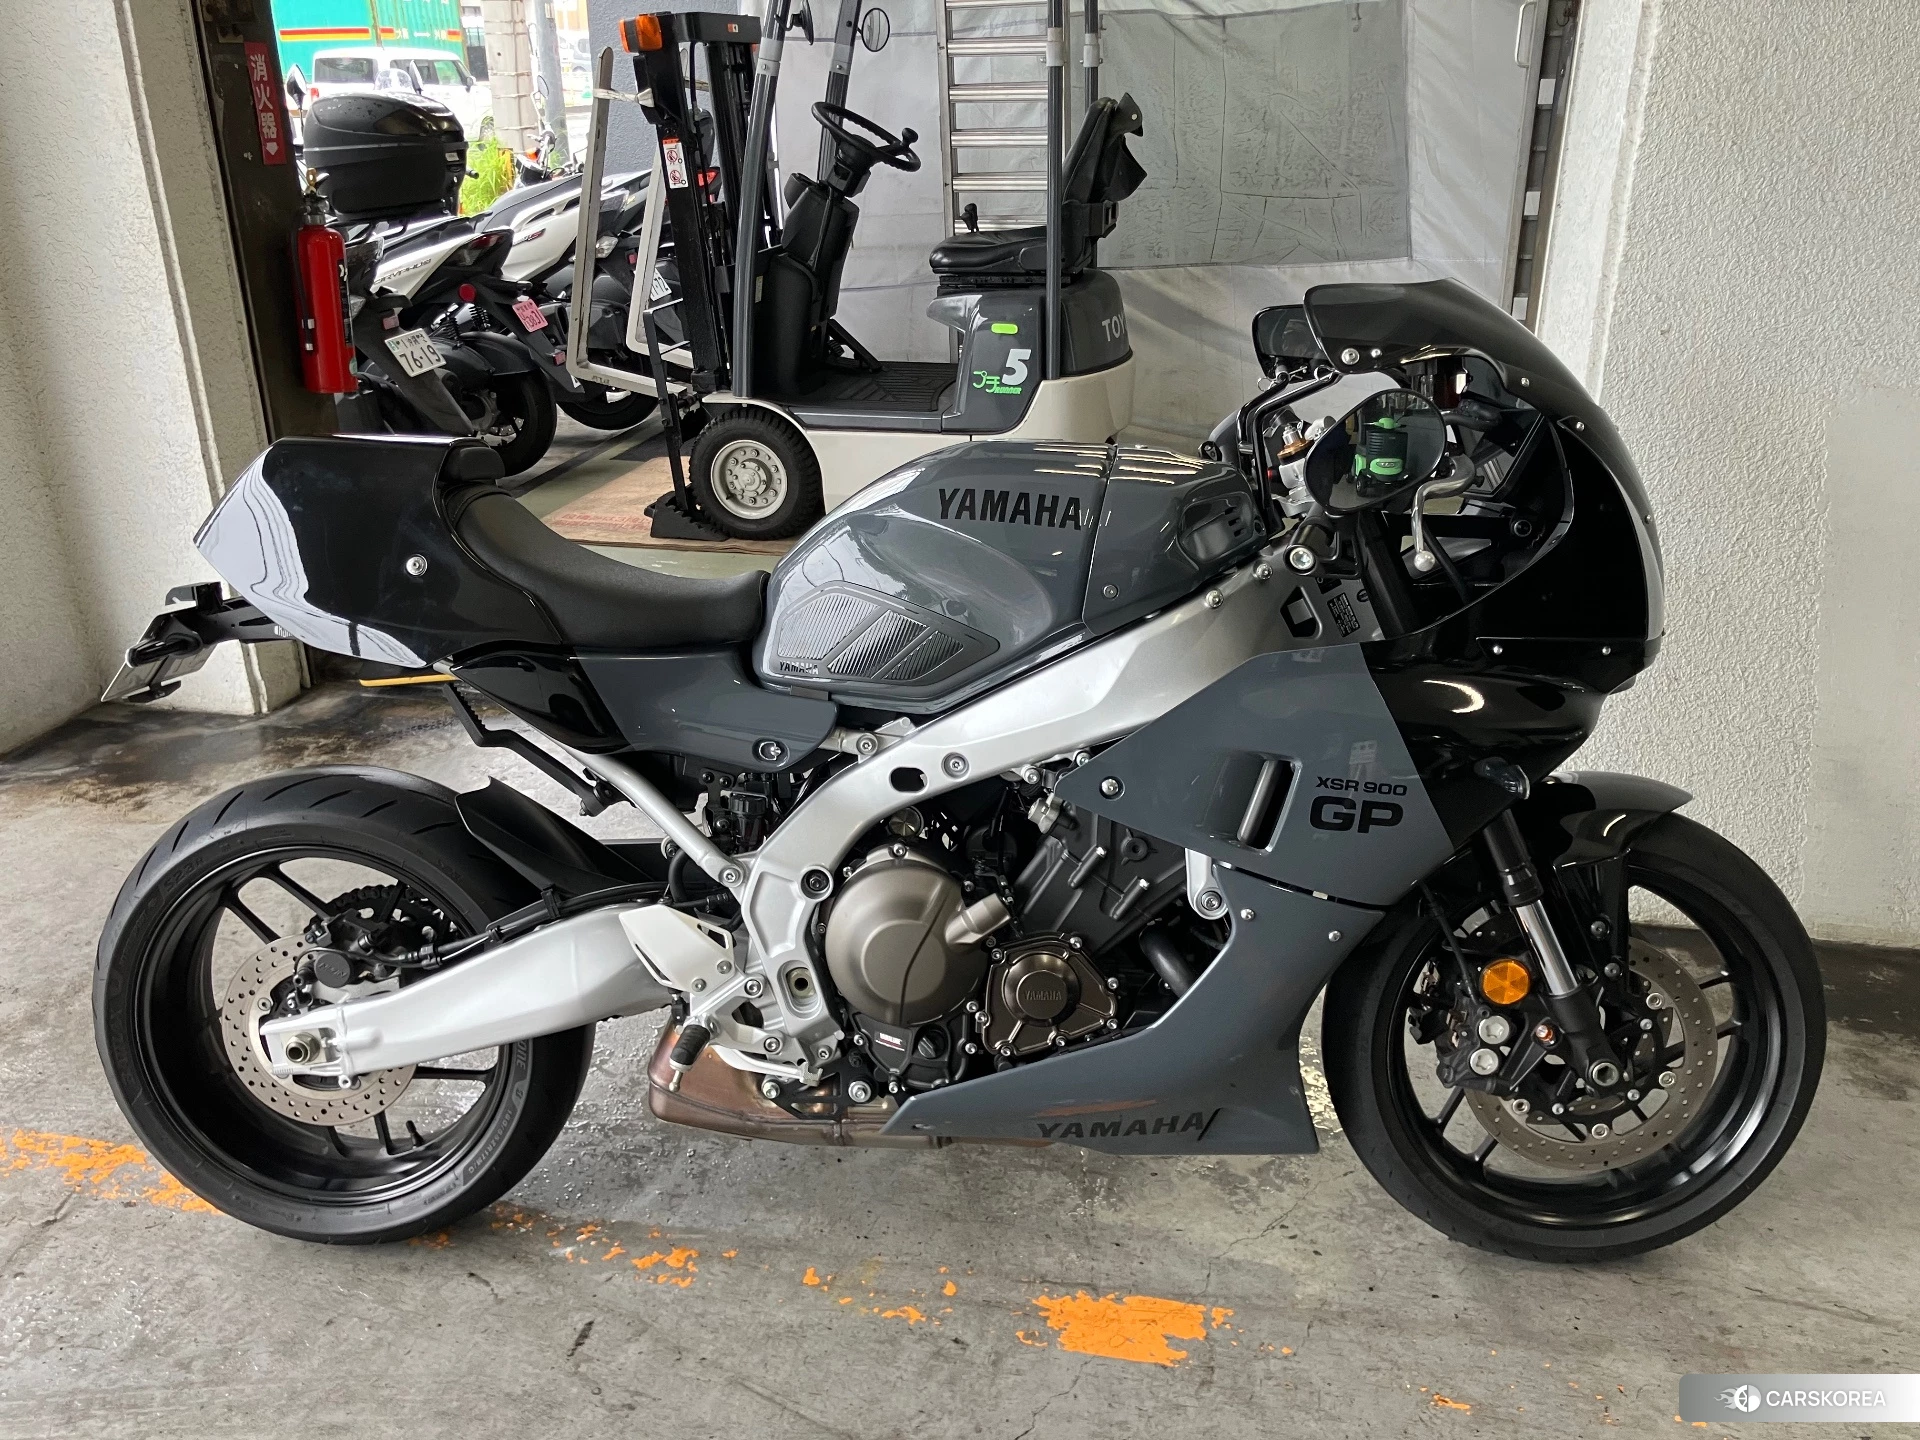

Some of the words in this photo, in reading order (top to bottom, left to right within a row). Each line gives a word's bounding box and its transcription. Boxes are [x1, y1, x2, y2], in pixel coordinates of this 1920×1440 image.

[250, 53, 278, 139] 消火器
[1001, 348, 1032, 386] 5
[938, 488, 1082, 531] YAMAHA
[779, 660, 819, 675] YAMAHA
[1315, 776, 1360, 792] XSR
[1362, 781, 1408, 797] 900
[1309, 795, 1404, 834] GP
[1025, 990, 1062, 1001] YAMAHA
[1036, 1112, 1205, 1139] YAMAHA
